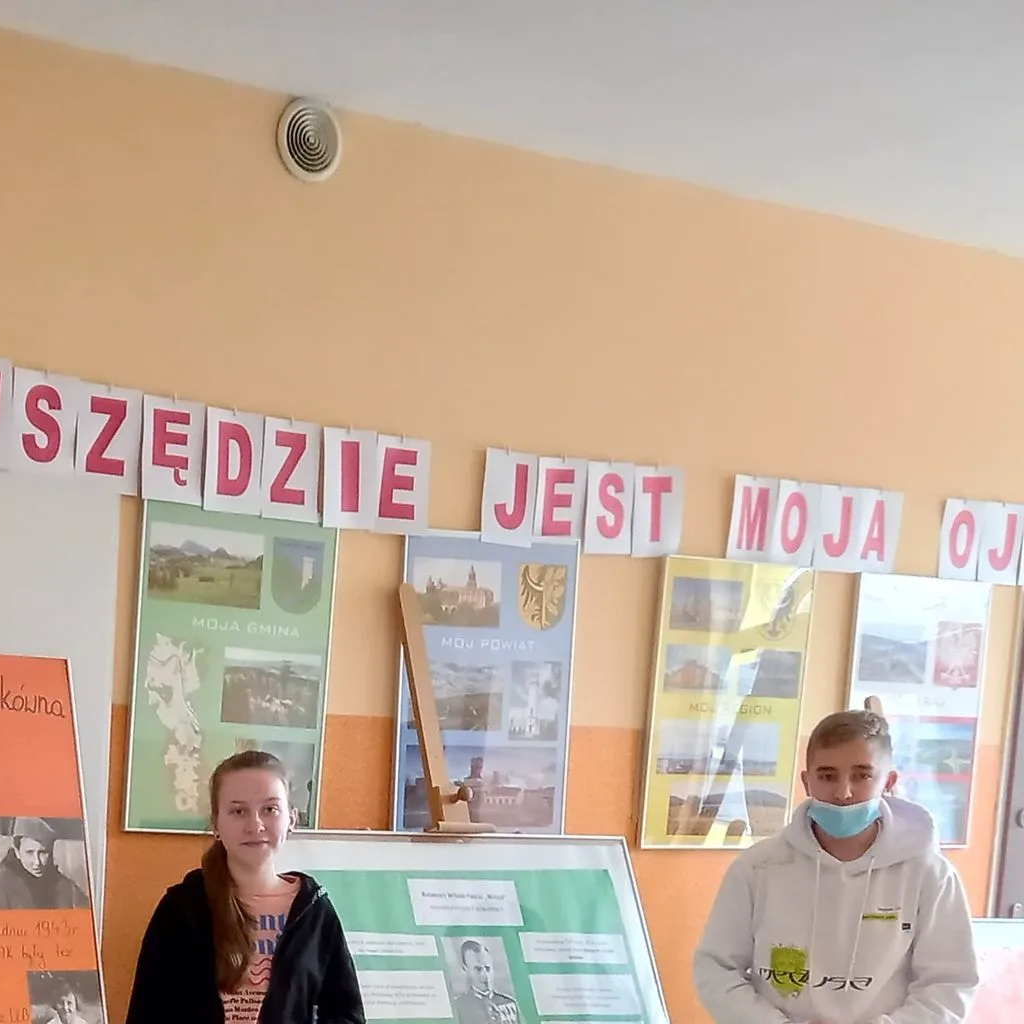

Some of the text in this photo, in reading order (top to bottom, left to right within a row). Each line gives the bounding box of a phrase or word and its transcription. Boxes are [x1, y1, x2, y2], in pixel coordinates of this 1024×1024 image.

[494, 463, 672, 542] JEST
[736, 485, 885, 562] MOJA
[192, 616, 300, 639] MOJA GMINA
[480, 638, 535, 651] POWIAT
